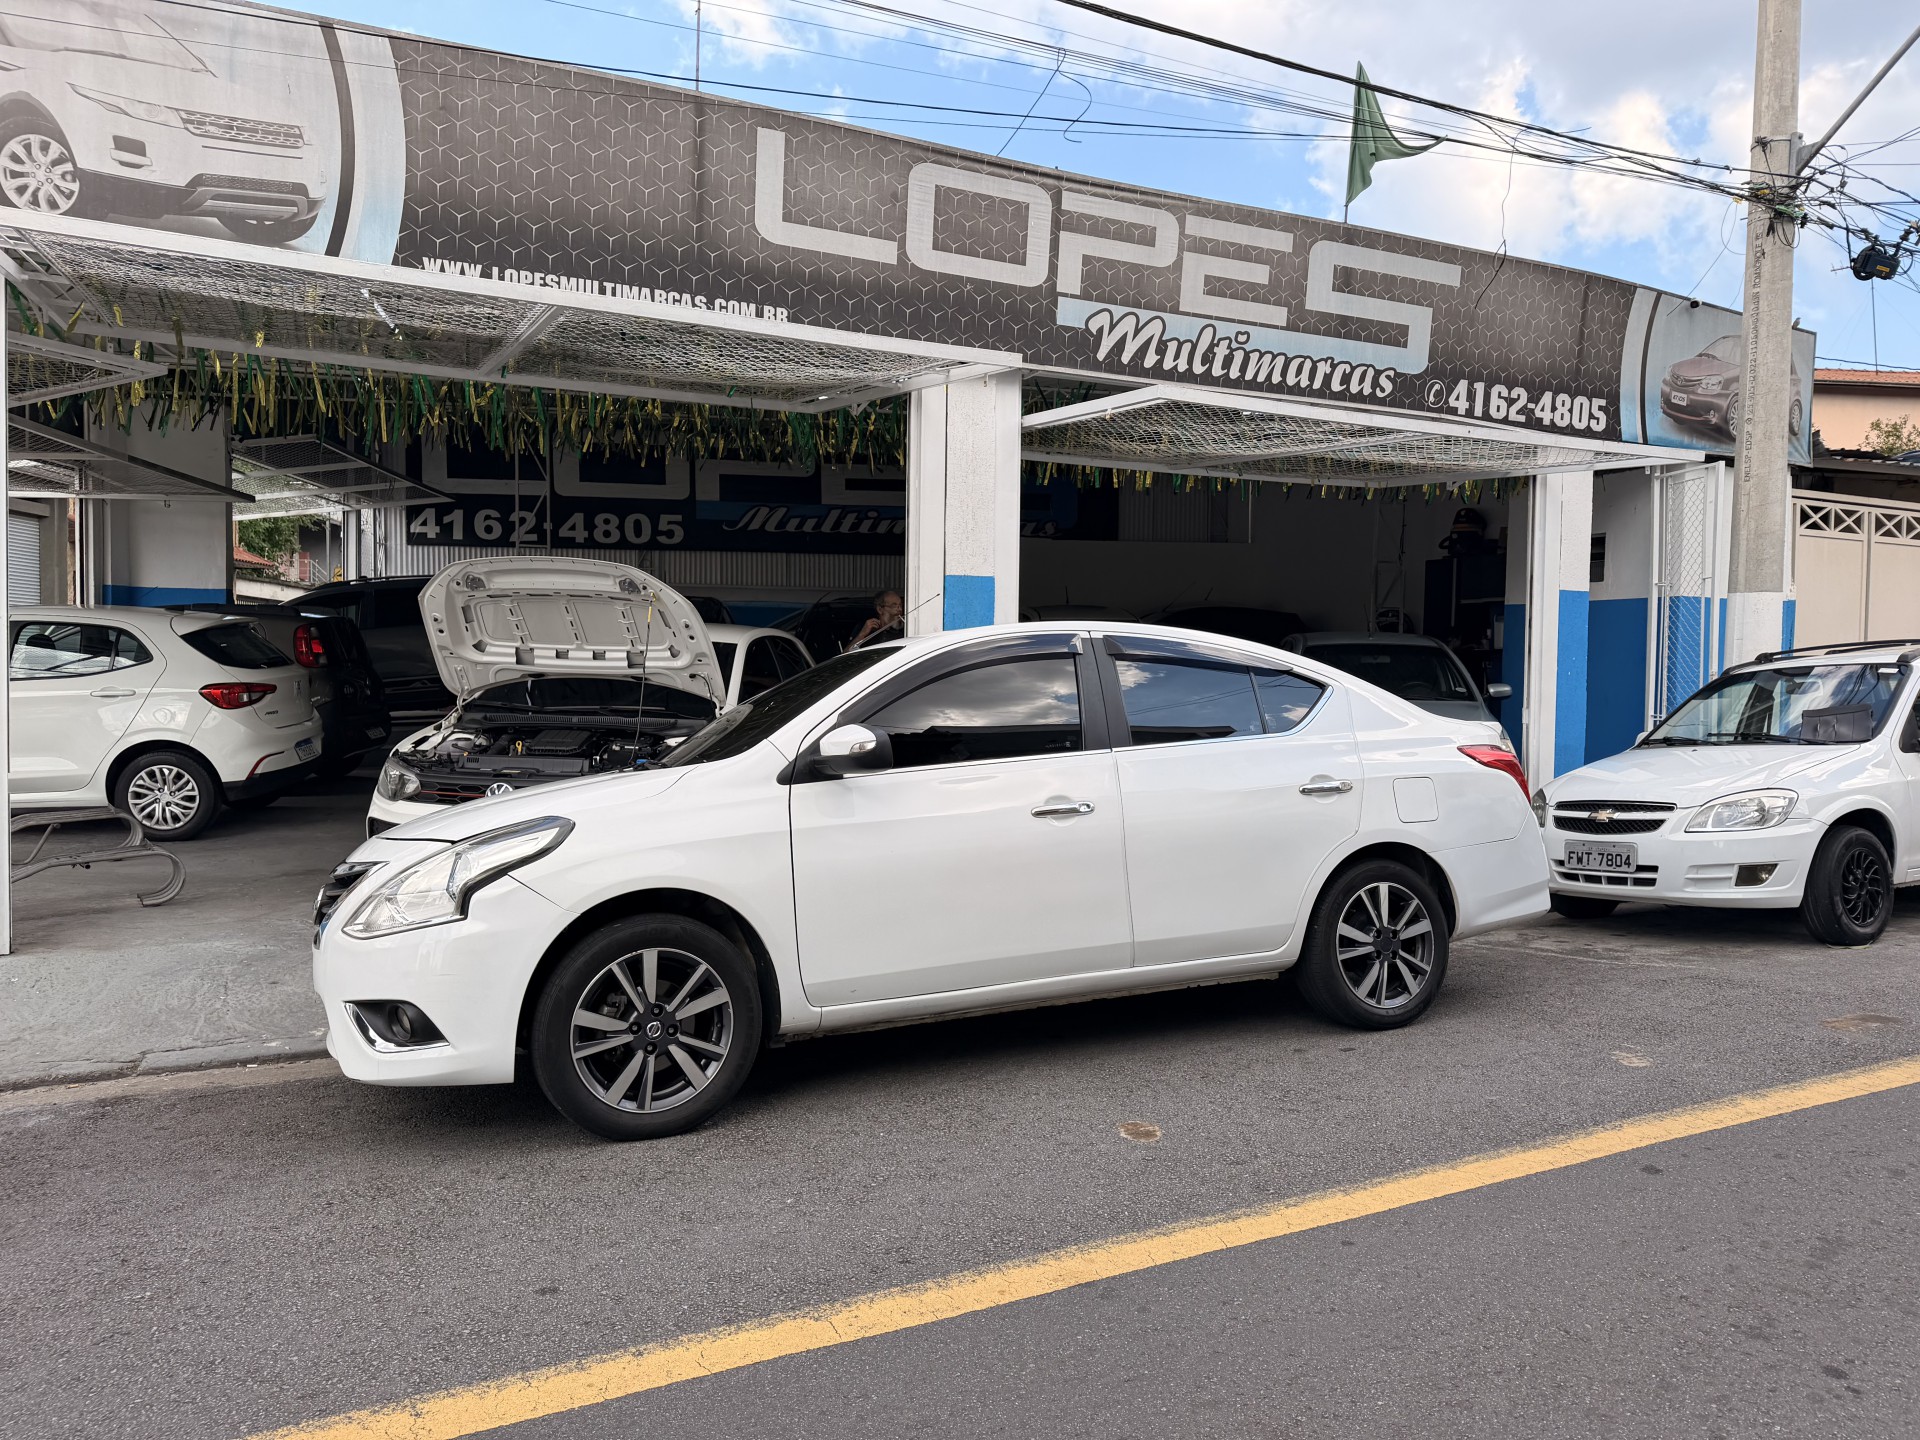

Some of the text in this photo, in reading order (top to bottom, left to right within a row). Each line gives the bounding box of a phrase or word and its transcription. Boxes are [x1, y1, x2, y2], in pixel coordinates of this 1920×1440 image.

[755, 126, 1461, 374] LOPES
[422, 256, 789, 323] WWWLOPESMULTIMARCASCOMBR
[1085, 308, 1398, 398] Multimarcas
[1449, 379, 1607, 432] 4162-4805
[409, 507, 685, 545] 4162-4805
